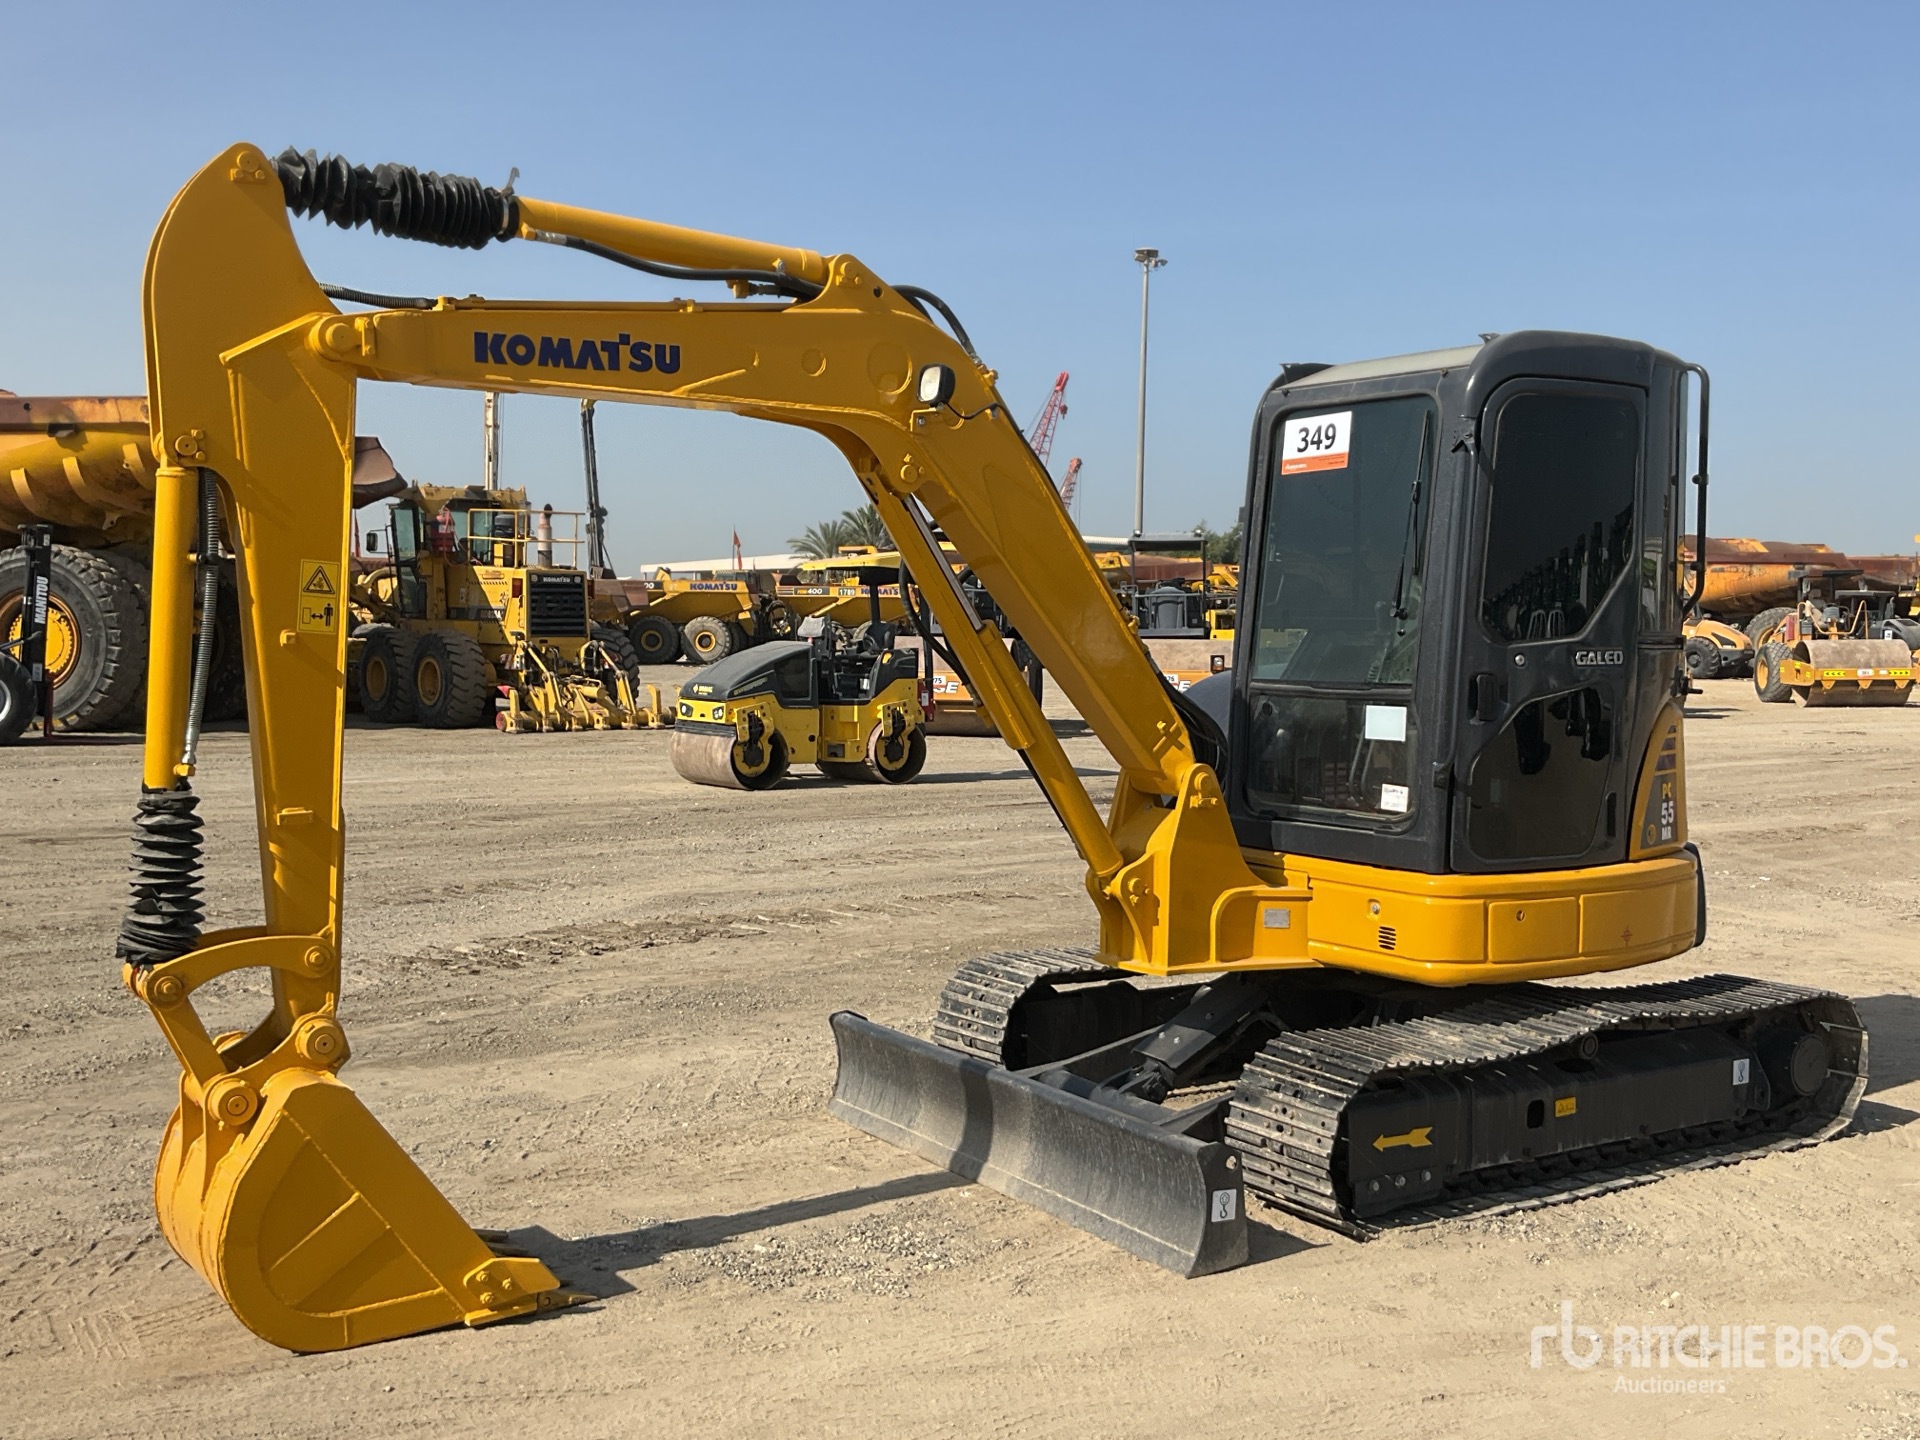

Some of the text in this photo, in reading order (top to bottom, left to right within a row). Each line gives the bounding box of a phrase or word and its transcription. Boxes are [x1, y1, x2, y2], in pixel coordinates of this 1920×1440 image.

[474, 331, 681, 374] KOMATSU
[1297, 423, 1337, 453] 349
[689, 582, 738, 591] KOMATSU
[34, 576, 49, 624] MANITOU
[1575, 650, 1624, 665] GALEO
[1662, 782, 1672, 799] PC
[1661, 801, 1674, 825] 55
[1661, 826, 1672, 840] MR
